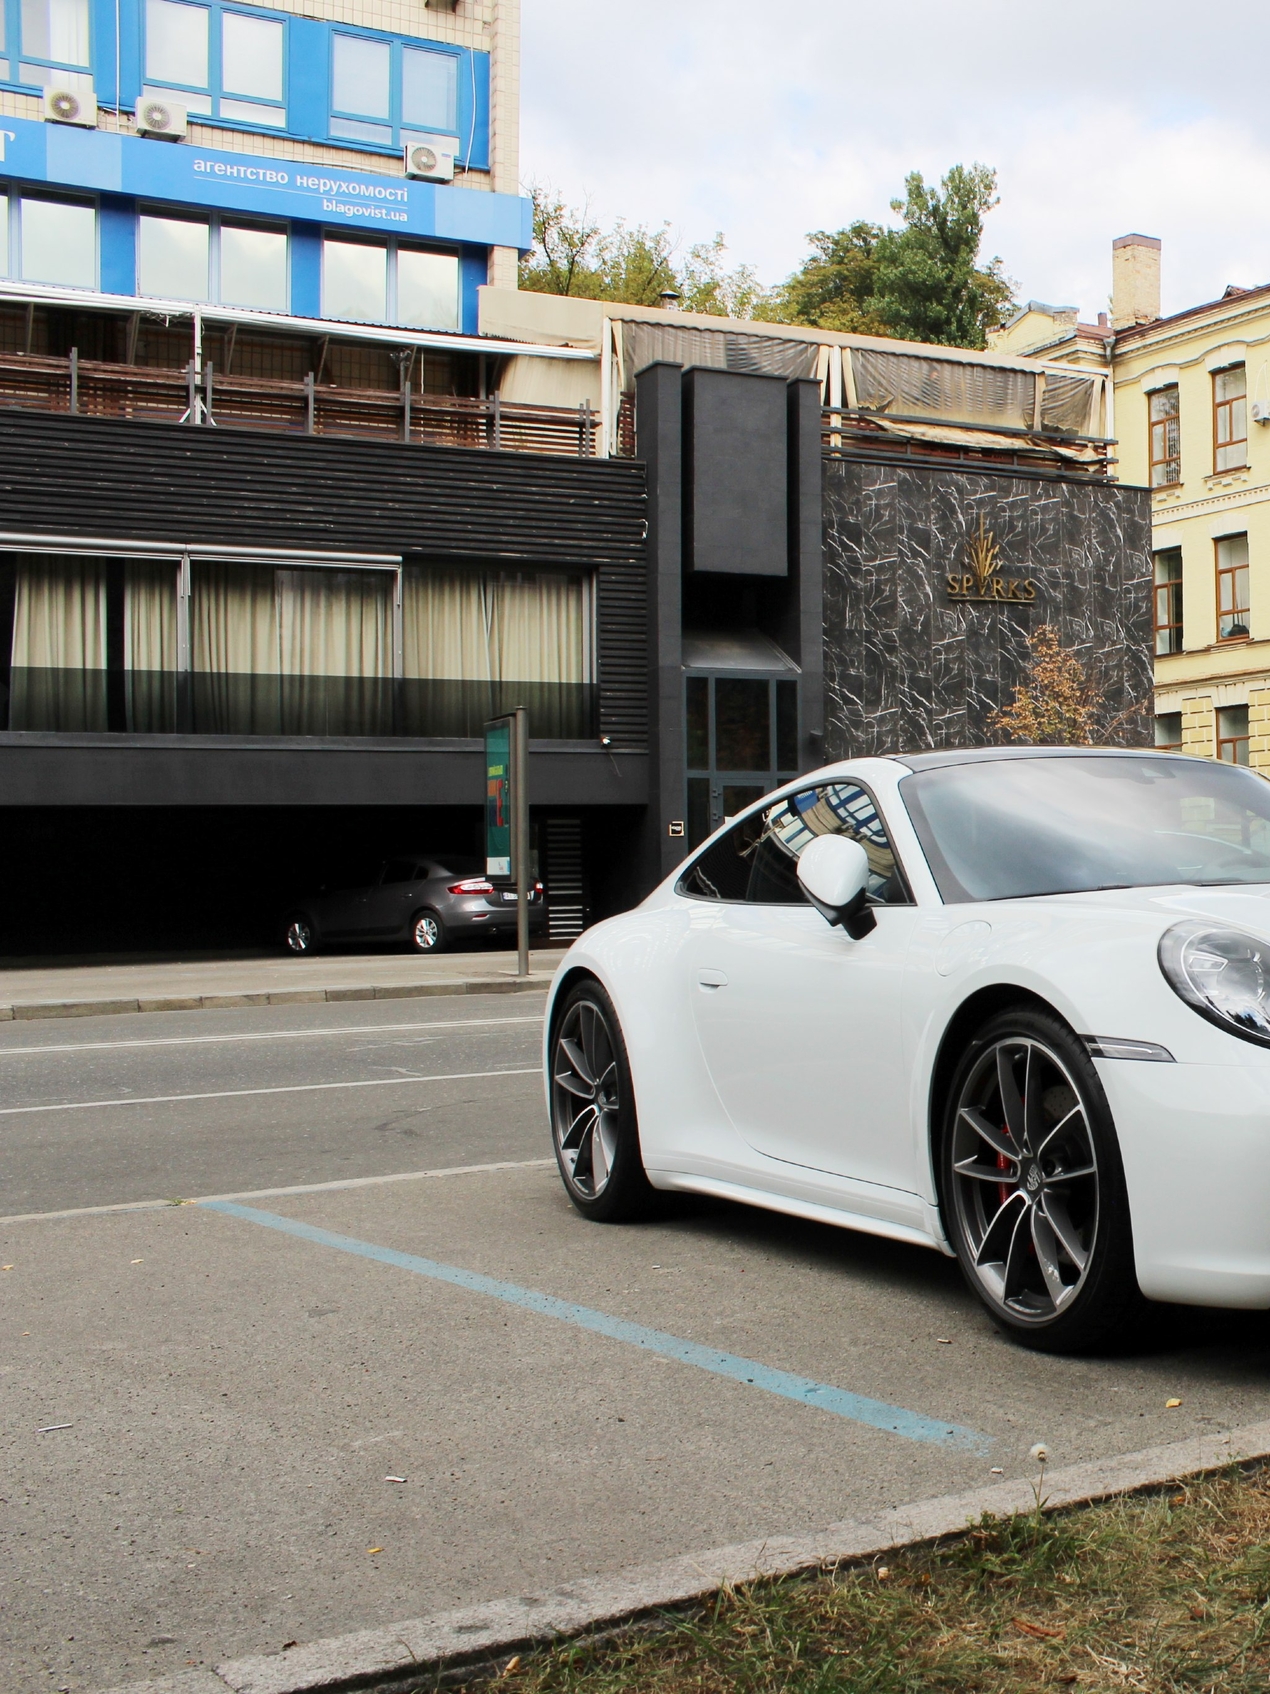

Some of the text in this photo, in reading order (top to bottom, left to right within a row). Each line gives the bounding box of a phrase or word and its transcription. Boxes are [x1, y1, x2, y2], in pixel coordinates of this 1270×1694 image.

[193, 158, 408, 202] агентство нерухомості
[323, 198, 408, 222] blagovist.ua
[947, 573, 1036, 599] SPARKS
